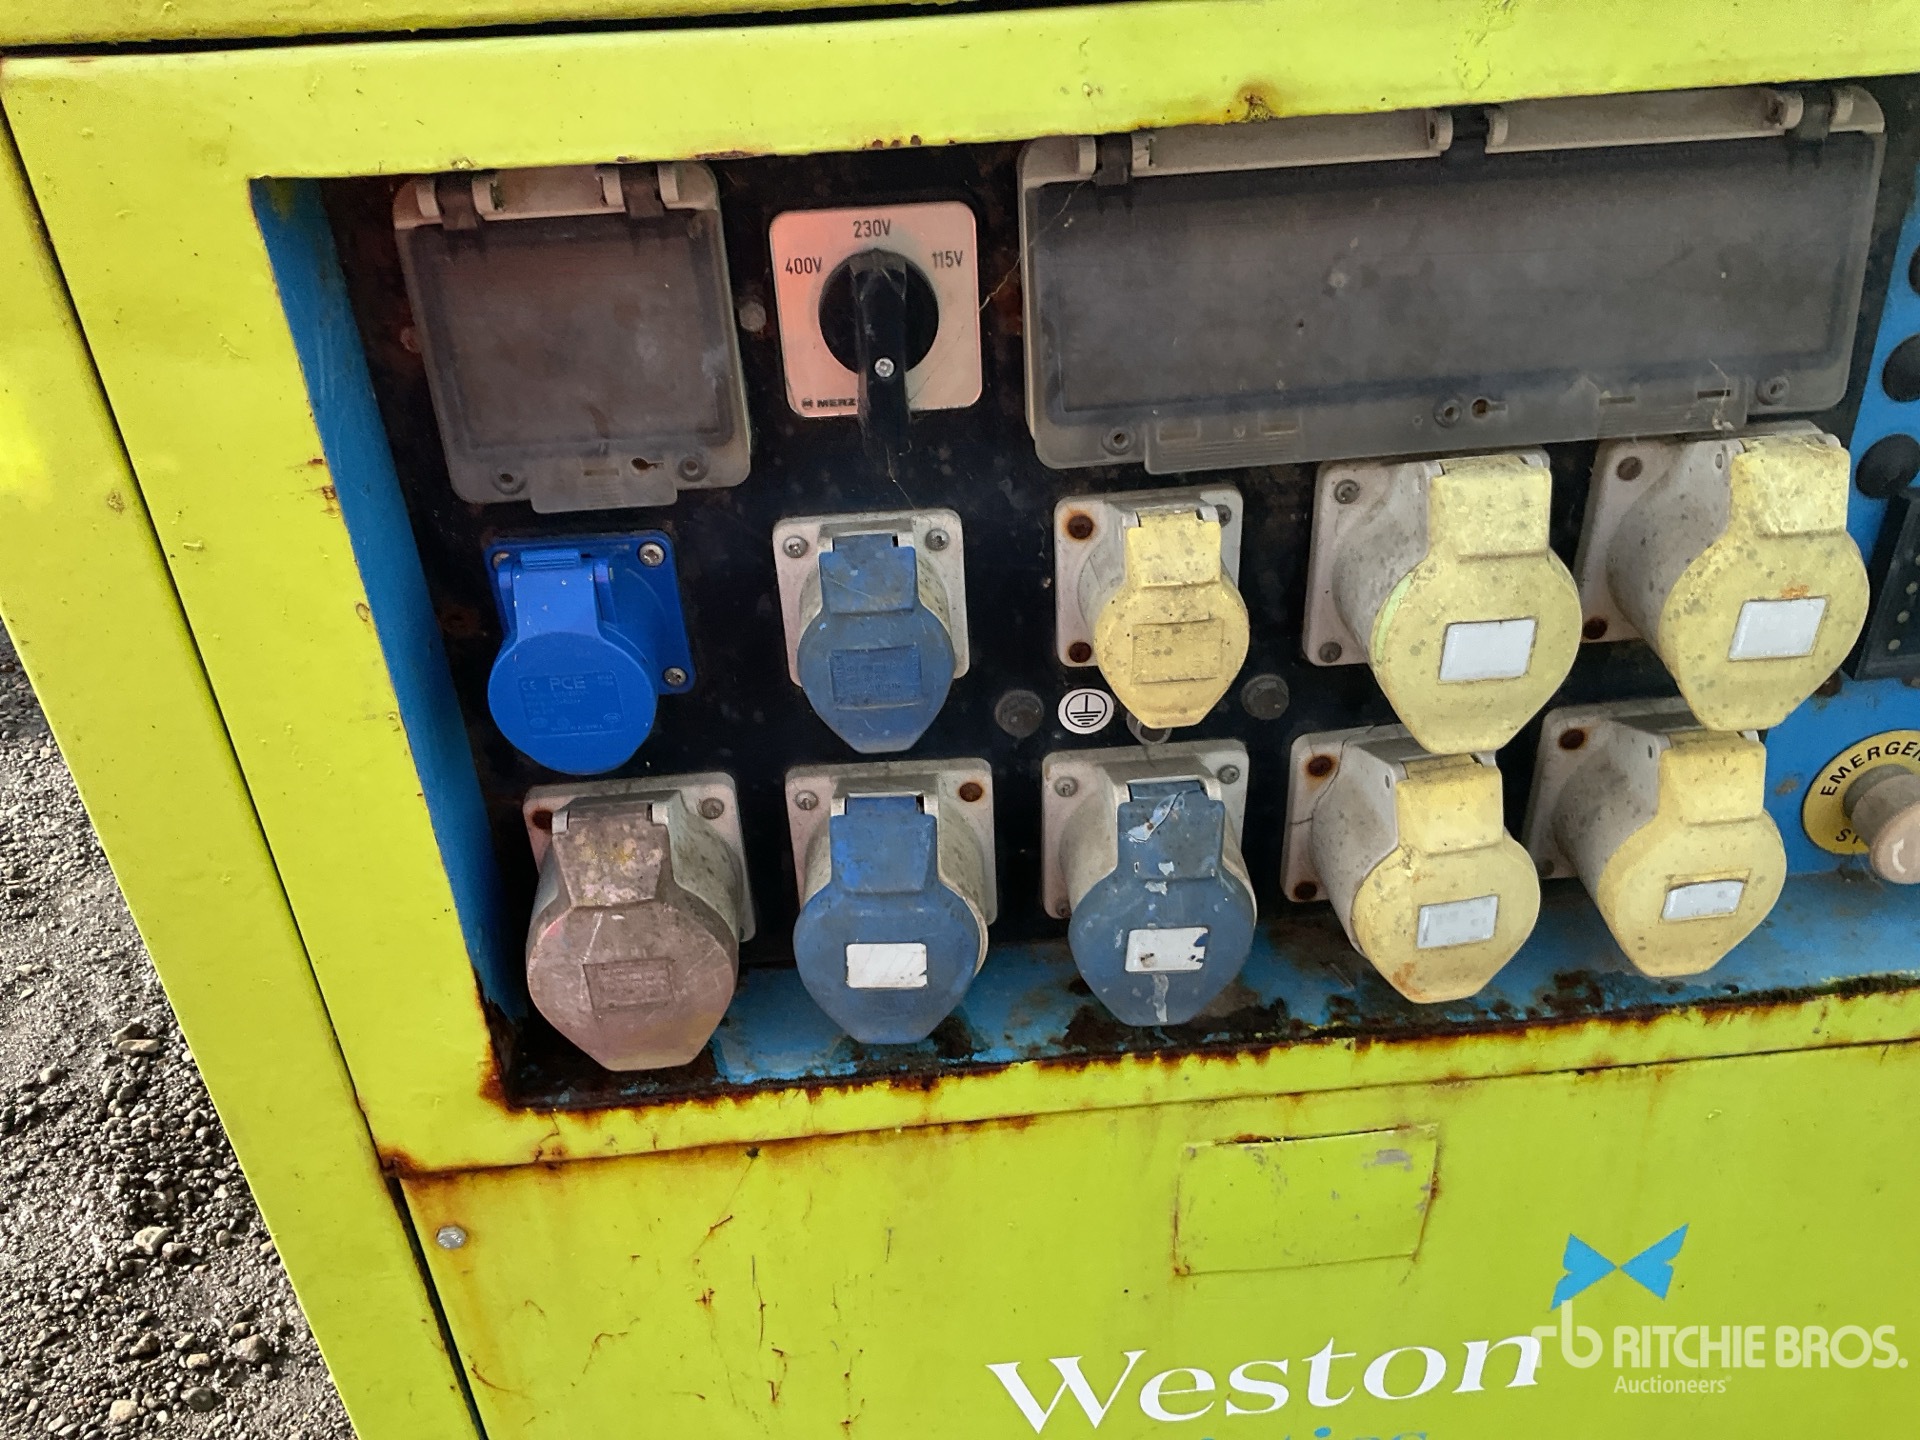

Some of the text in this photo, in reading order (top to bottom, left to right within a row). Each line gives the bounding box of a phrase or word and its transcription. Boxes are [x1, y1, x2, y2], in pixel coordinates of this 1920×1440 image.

[853, 220, 891, 237] 230V
[785, 257, 822, 275] 400V
[932, 251, 963, 268] 115V
[817, 398, 857, 408] MERZ
[985, 1336, 1541, 1434] Weston
